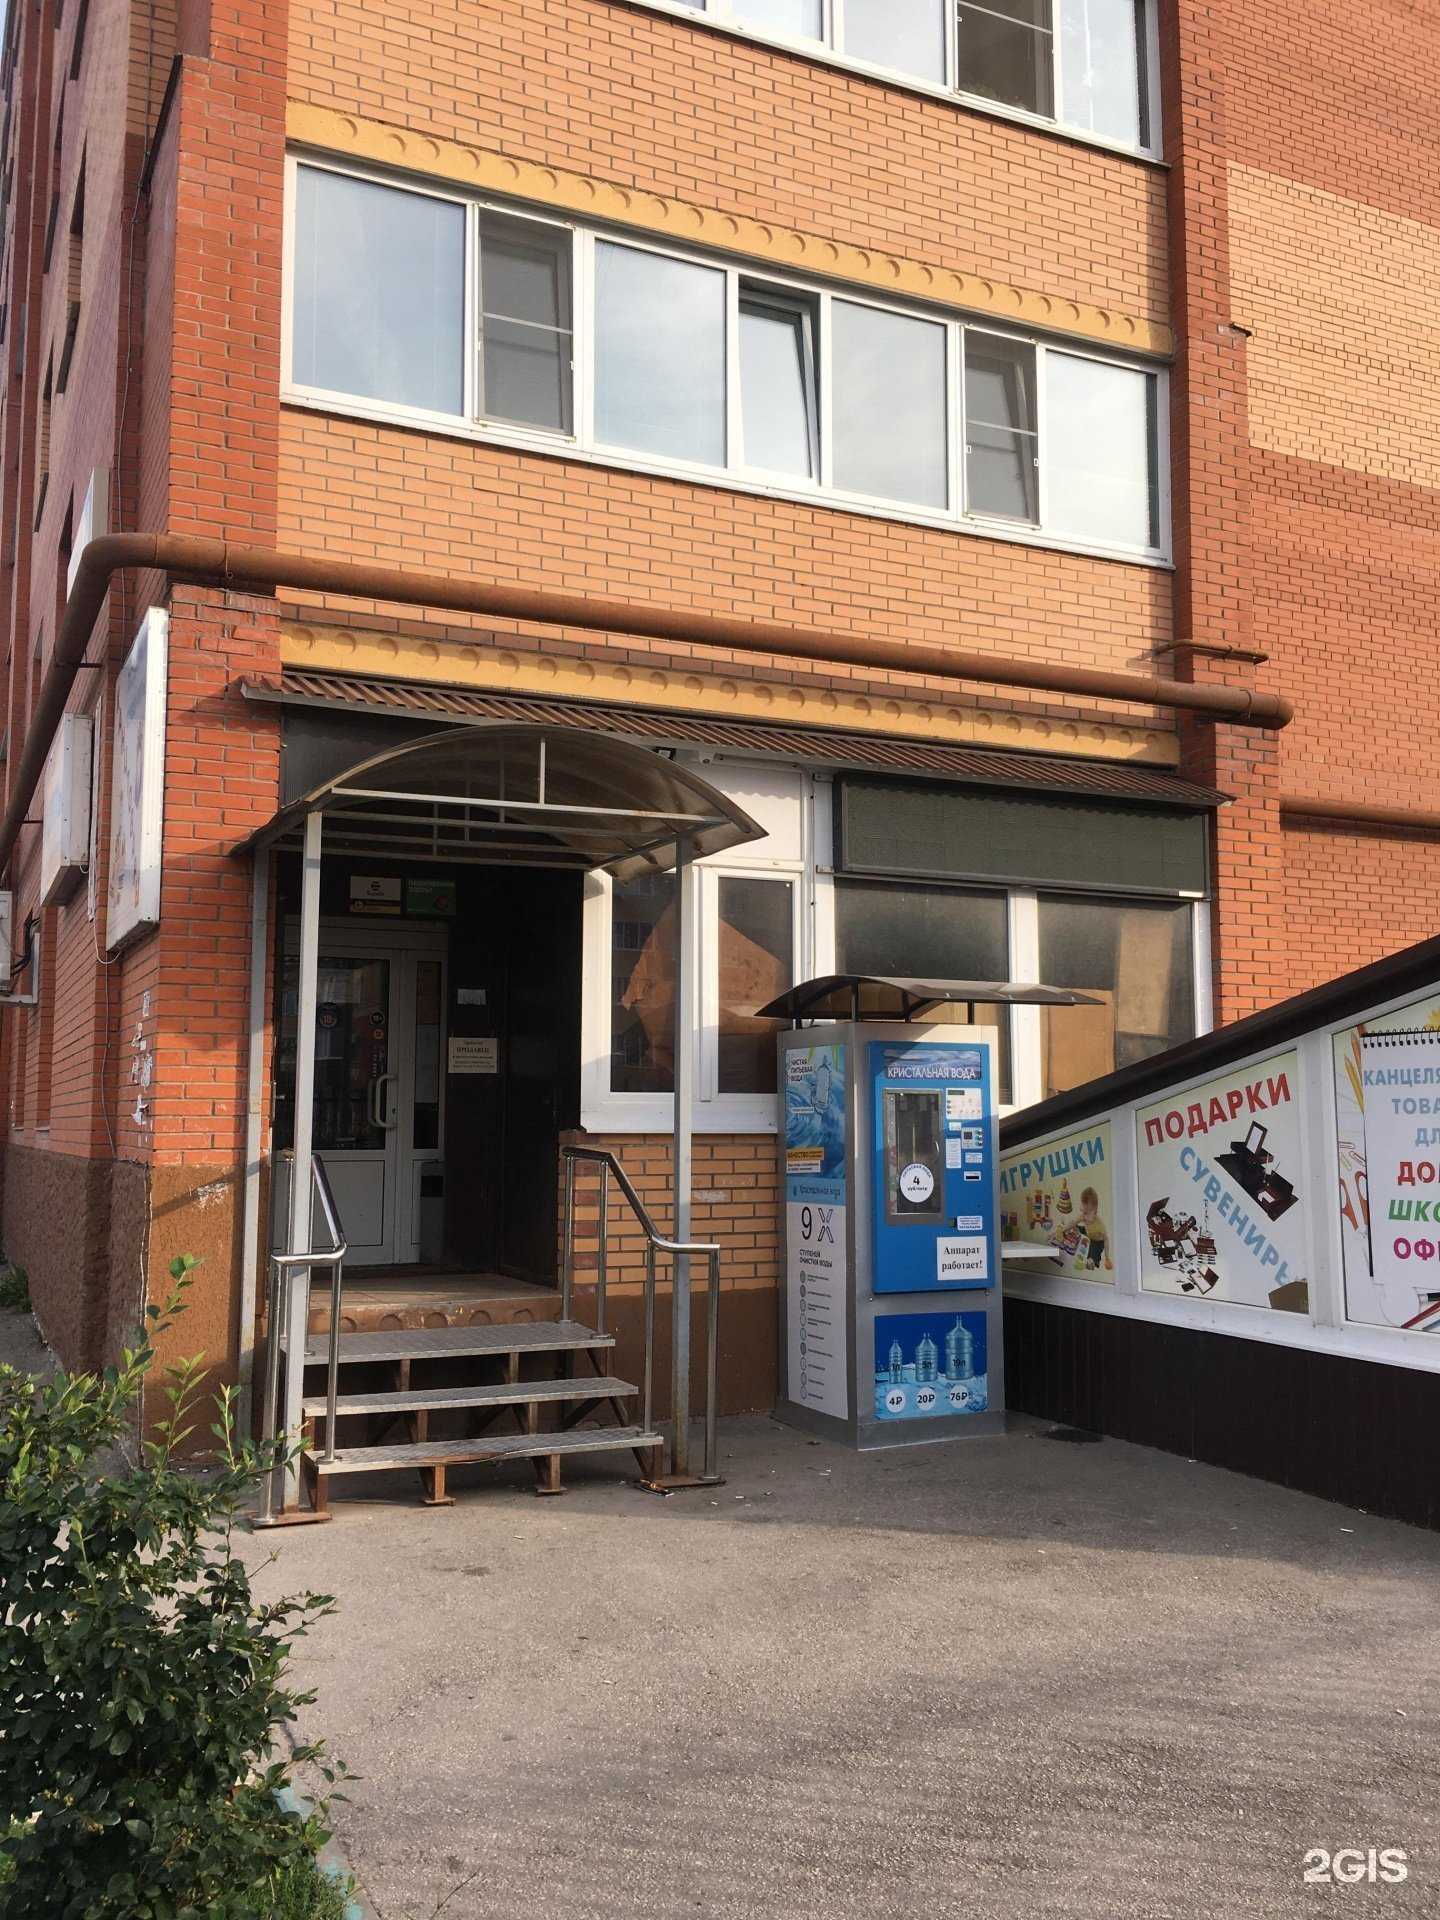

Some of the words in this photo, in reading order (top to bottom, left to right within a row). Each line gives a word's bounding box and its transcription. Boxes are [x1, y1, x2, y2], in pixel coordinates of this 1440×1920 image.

[887, 1066, 950, 1080] КРИСТАЛЬНАЯ
[951, 1066, 977, 1081] ВОДА
[1144, 1073, 1292, 1147] ПОДАРКИ
[912, 1175, 921, 1186] 4
[1397, 1161, 1440, 1187] ДО
[801, 1206, 812, 1240] 9
[943, 1246, 981, 1257] Аппарат
[1392, 1237, 1440, 1262] ОФ
[941, 1259, 984, 1273] работает!
